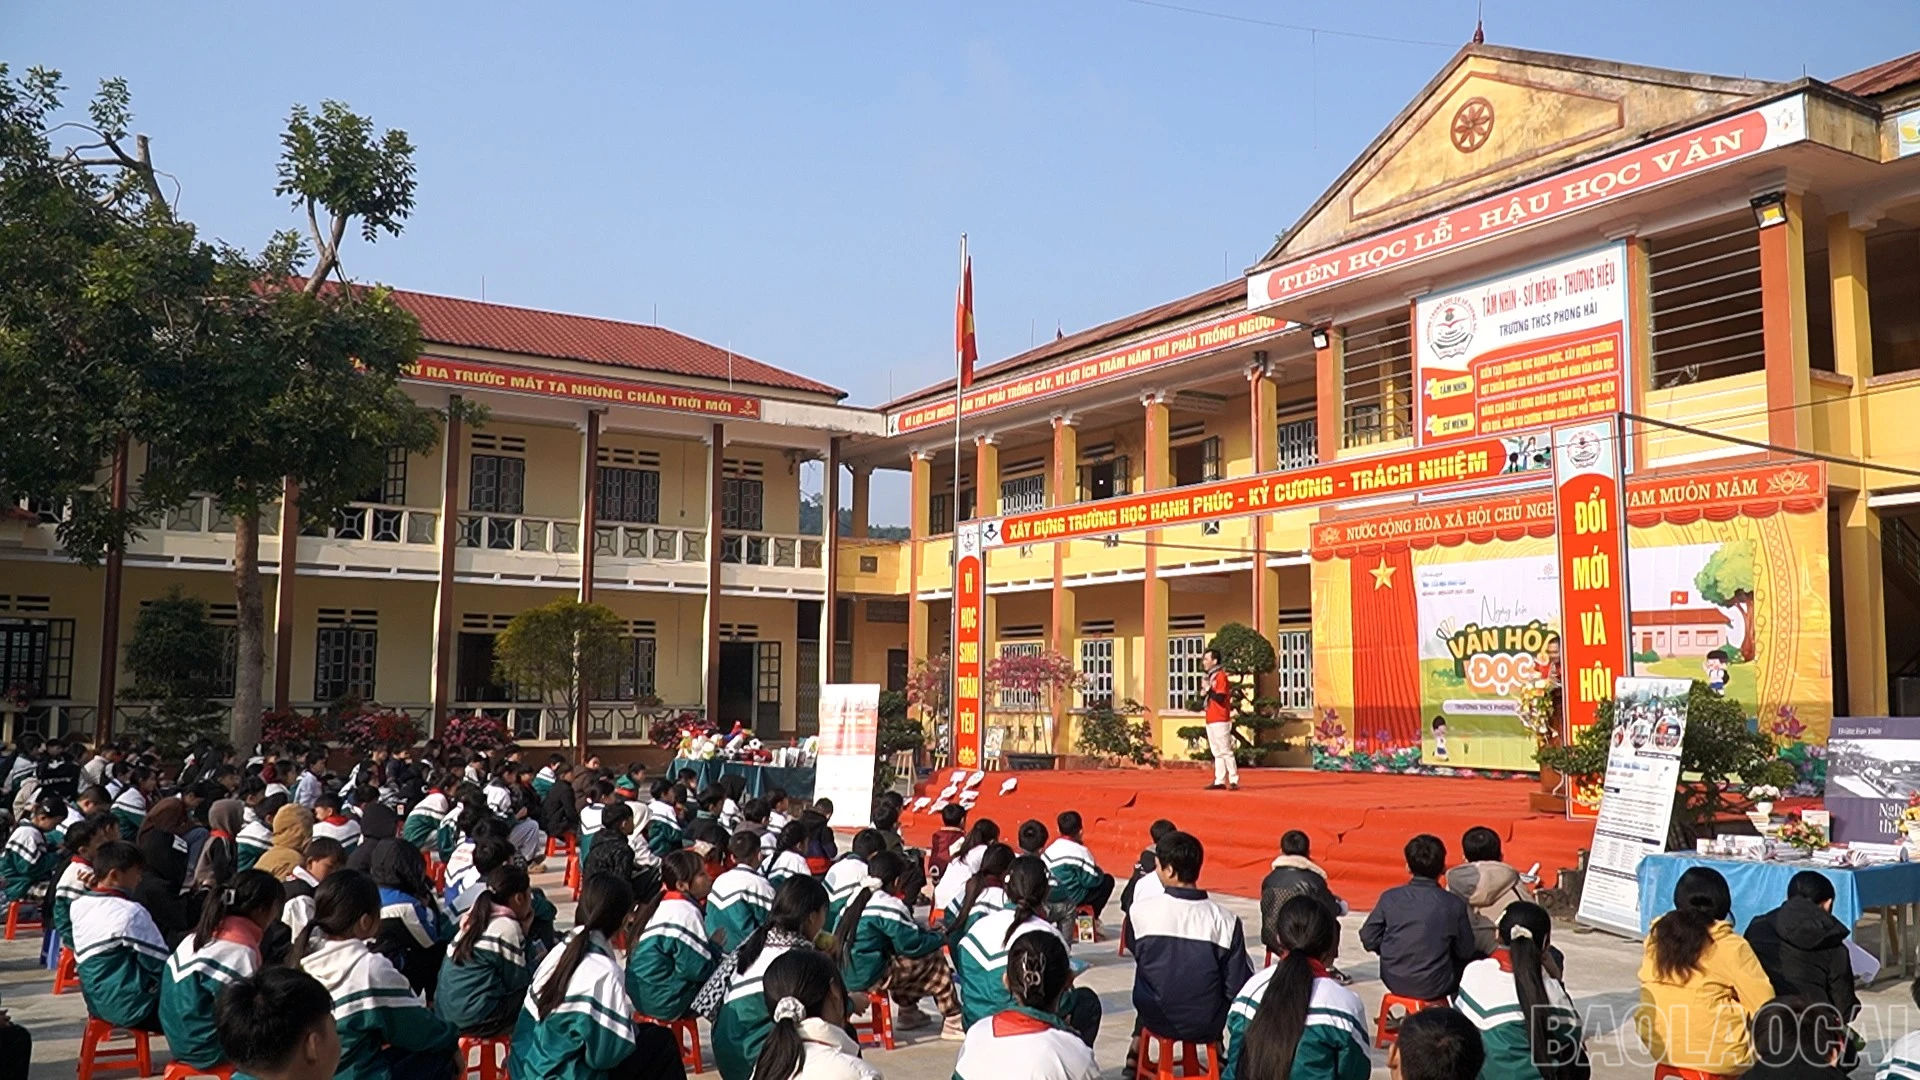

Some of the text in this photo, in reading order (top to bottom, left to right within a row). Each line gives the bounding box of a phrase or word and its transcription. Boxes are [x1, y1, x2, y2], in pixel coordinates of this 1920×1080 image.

[1279, 260, 1341, 292] TIÊN
[1348, 240, 1407, 272] HỌC
[1414, 217, 1453, 251] LỄ
[1479, 192, 1551, 231] HẬU
[1562, 162, 1641, 204] HỌC
[1652, 129, 1744, 173] VĂN
[1564, 267, 1595, 296] THƯƠNG
[1597, 258, 1616, 291] HIỆU
[1531, 313, 1551, 329] THCS
[1553, 305, 1581, 324] PHONG
[1082, 364, 1097, 379] ÍCH
[1099, 354, 1126, 374] TRĂM
[1128, 347, 1151, 369] NĂM
[1153, 341, 1170, 361] THÌ
[1171, 332, 1196, 354] PHẢI
[426, 367, 449, 379] RA
[453, 369, 506, 386] TRƯỚC
[548, 380, 567, 394] TA
[705, 399, 731, 413] MỚI
[1009, 519, 1035, 540] XÂY
[1034, 518, 1065, 538] DỰNG
[1068, 508, 1117, 531] TRƯỜNG
[1120, 504, 1147, 526] HỌC
[1150, 499, 1190, 523] HẠNH
[1193, 489, 1233, 514] PHÚC
[1248, 479, 1270, 506] KỶ
[1274, 476, 1333, 503] CƯƠNG
[1350, 463, 1413, 491] TRÁCH
[1418, 450, 1488, 481] NHIỆM
[1574, 486, 1608, 534] ĐỔI
[1626, 476, 1759, 507] AM MUÔN NĂM
[1346, 522, 1377, 541] NƯỚC
[1379, 517, 1412, 539] CỘNG
[1415, 513, 1441, 532] HÒA
[1445, 510, 1464, 528] XÃ
[1467, 506, 1491, 529] HỘI
[1494, 498, 1523, 521] CHỦ
[1572, 545, 1610, 590] MỚI
[961, 606, 977, 633] HỌC
[1580, 604, 1607, 646] VÀ
[1448, 625, 1499, 658] VĂN
[1470, 655, 1532, 692] ĐỌC
[1579, 660, 1612, 708] HỘI
[1879, 802, 1908, 819] Ngh
